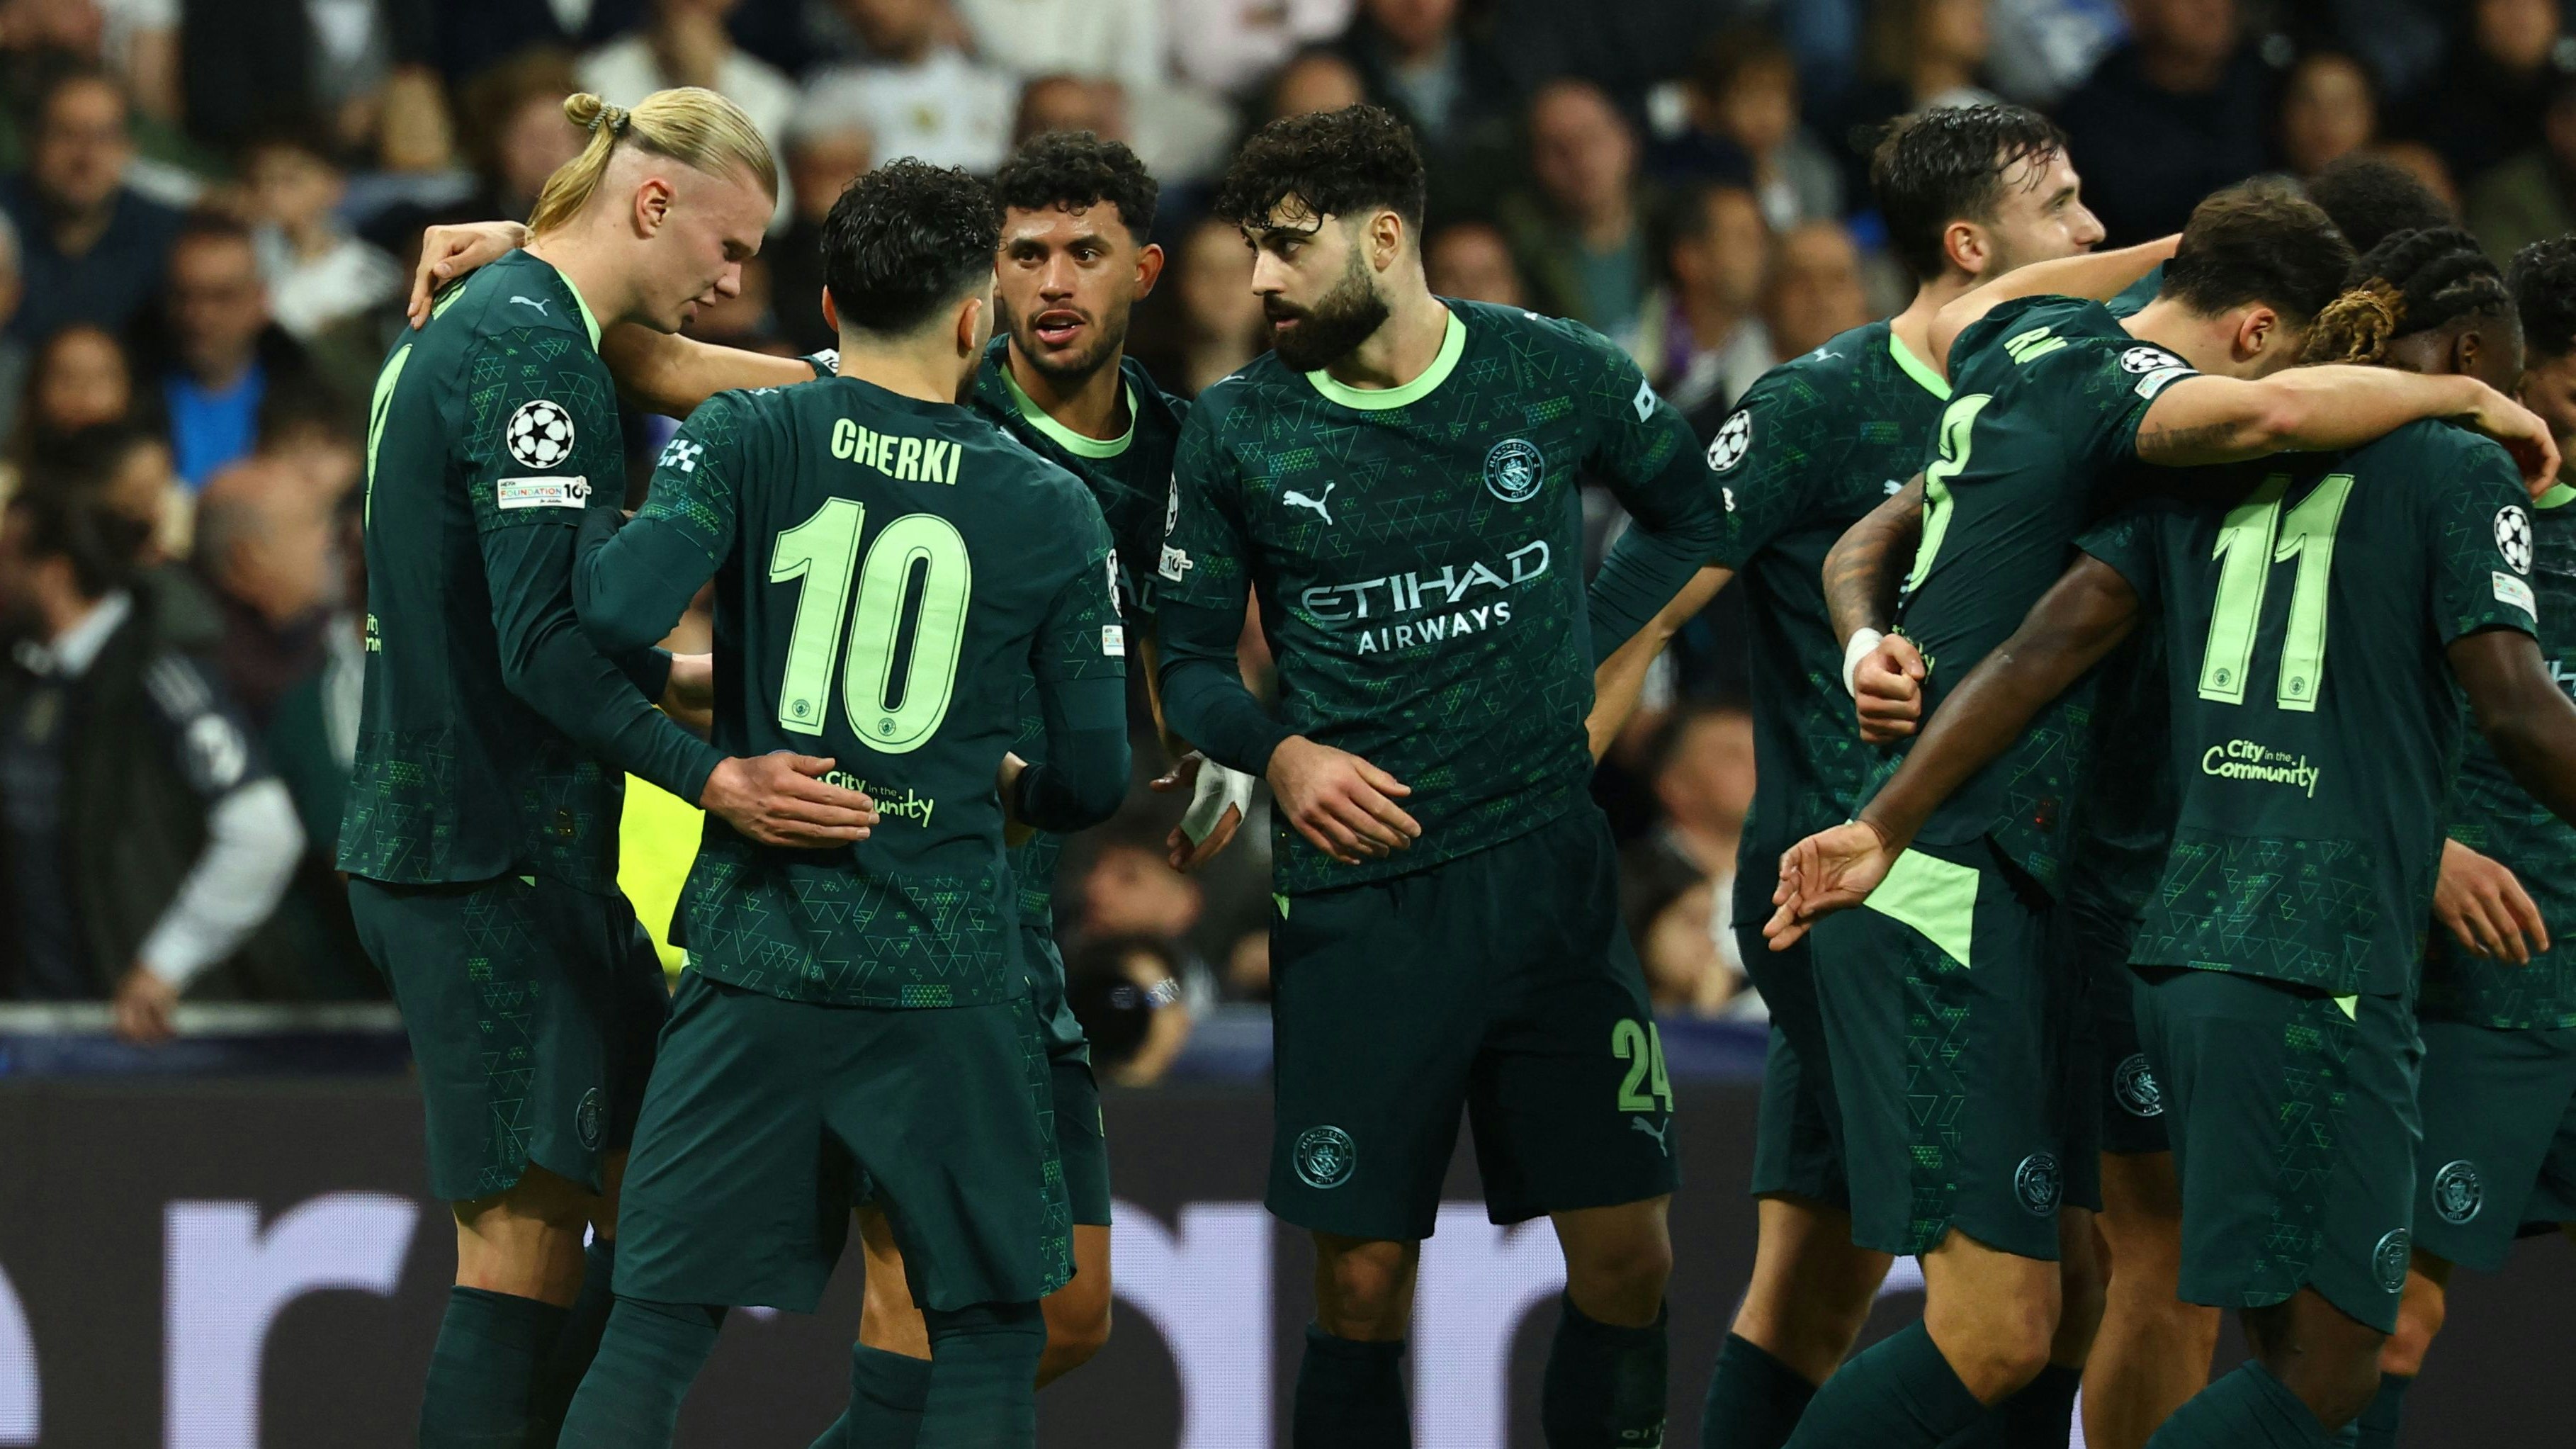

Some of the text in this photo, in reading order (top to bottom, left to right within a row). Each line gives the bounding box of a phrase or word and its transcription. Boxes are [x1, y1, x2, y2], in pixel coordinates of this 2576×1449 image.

[831, 417, 962, 485] CHERKI
[500, 487, 562, 497] FOUNDATION
[1510, 488, 1529, 498] CITY
[1301, 540, 1550, 621] ETIHAD
[2198, 473, 2356, 713] 11
[769, 496, 972, 755] 10
[1357, 601, 1512, 656] AIRWAYS
[2202, 745, 2320, 799] Community
[2227, 739, 2293, 763] City in the
[825, 770, 867, 793] City
[880, 786, 898, 797] the
[874, 787, 934, 828] unity
[1612, 1018, 1673, 1113] 24
